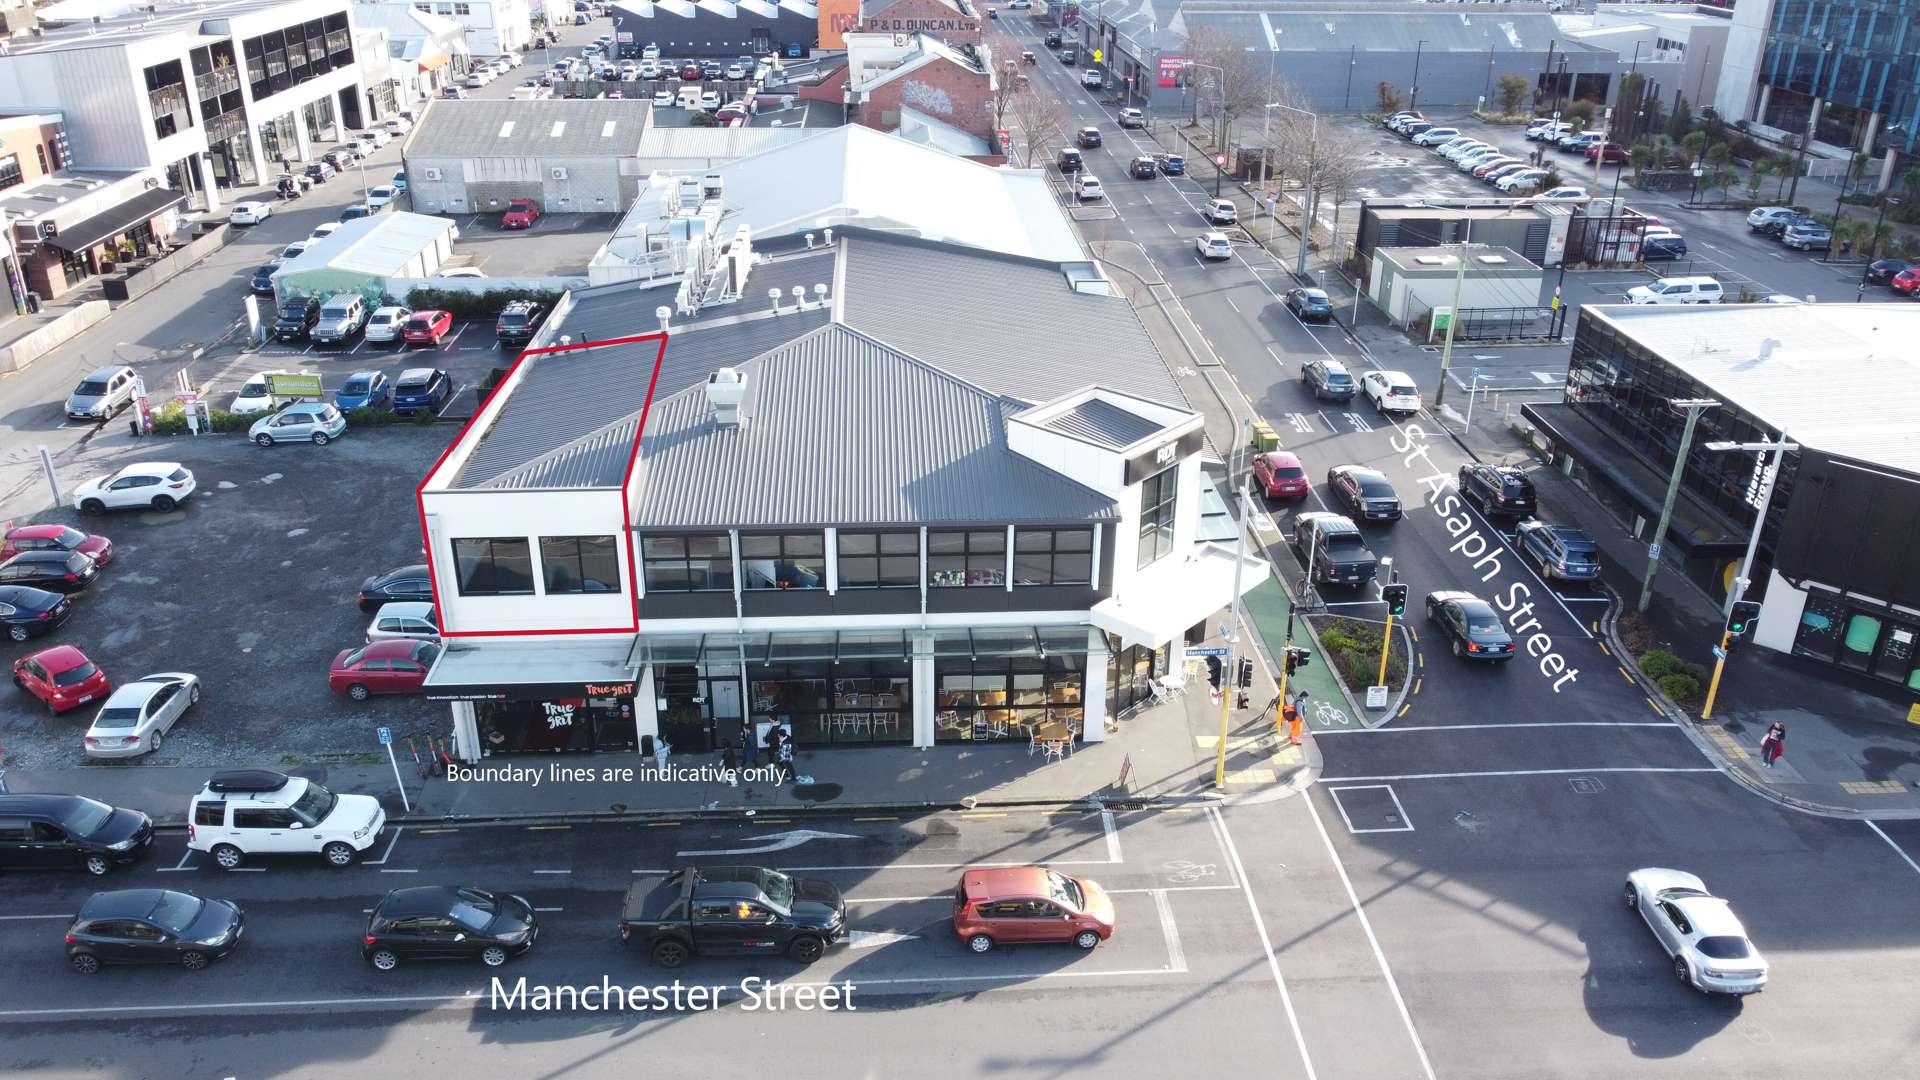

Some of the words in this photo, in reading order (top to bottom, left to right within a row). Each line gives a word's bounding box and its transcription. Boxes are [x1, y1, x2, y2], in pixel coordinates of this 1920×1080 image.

[870, 19, 878, 30] P
[881, 19, 890, 30] &
[1745, 432, 1772, 505] Hierarcy
